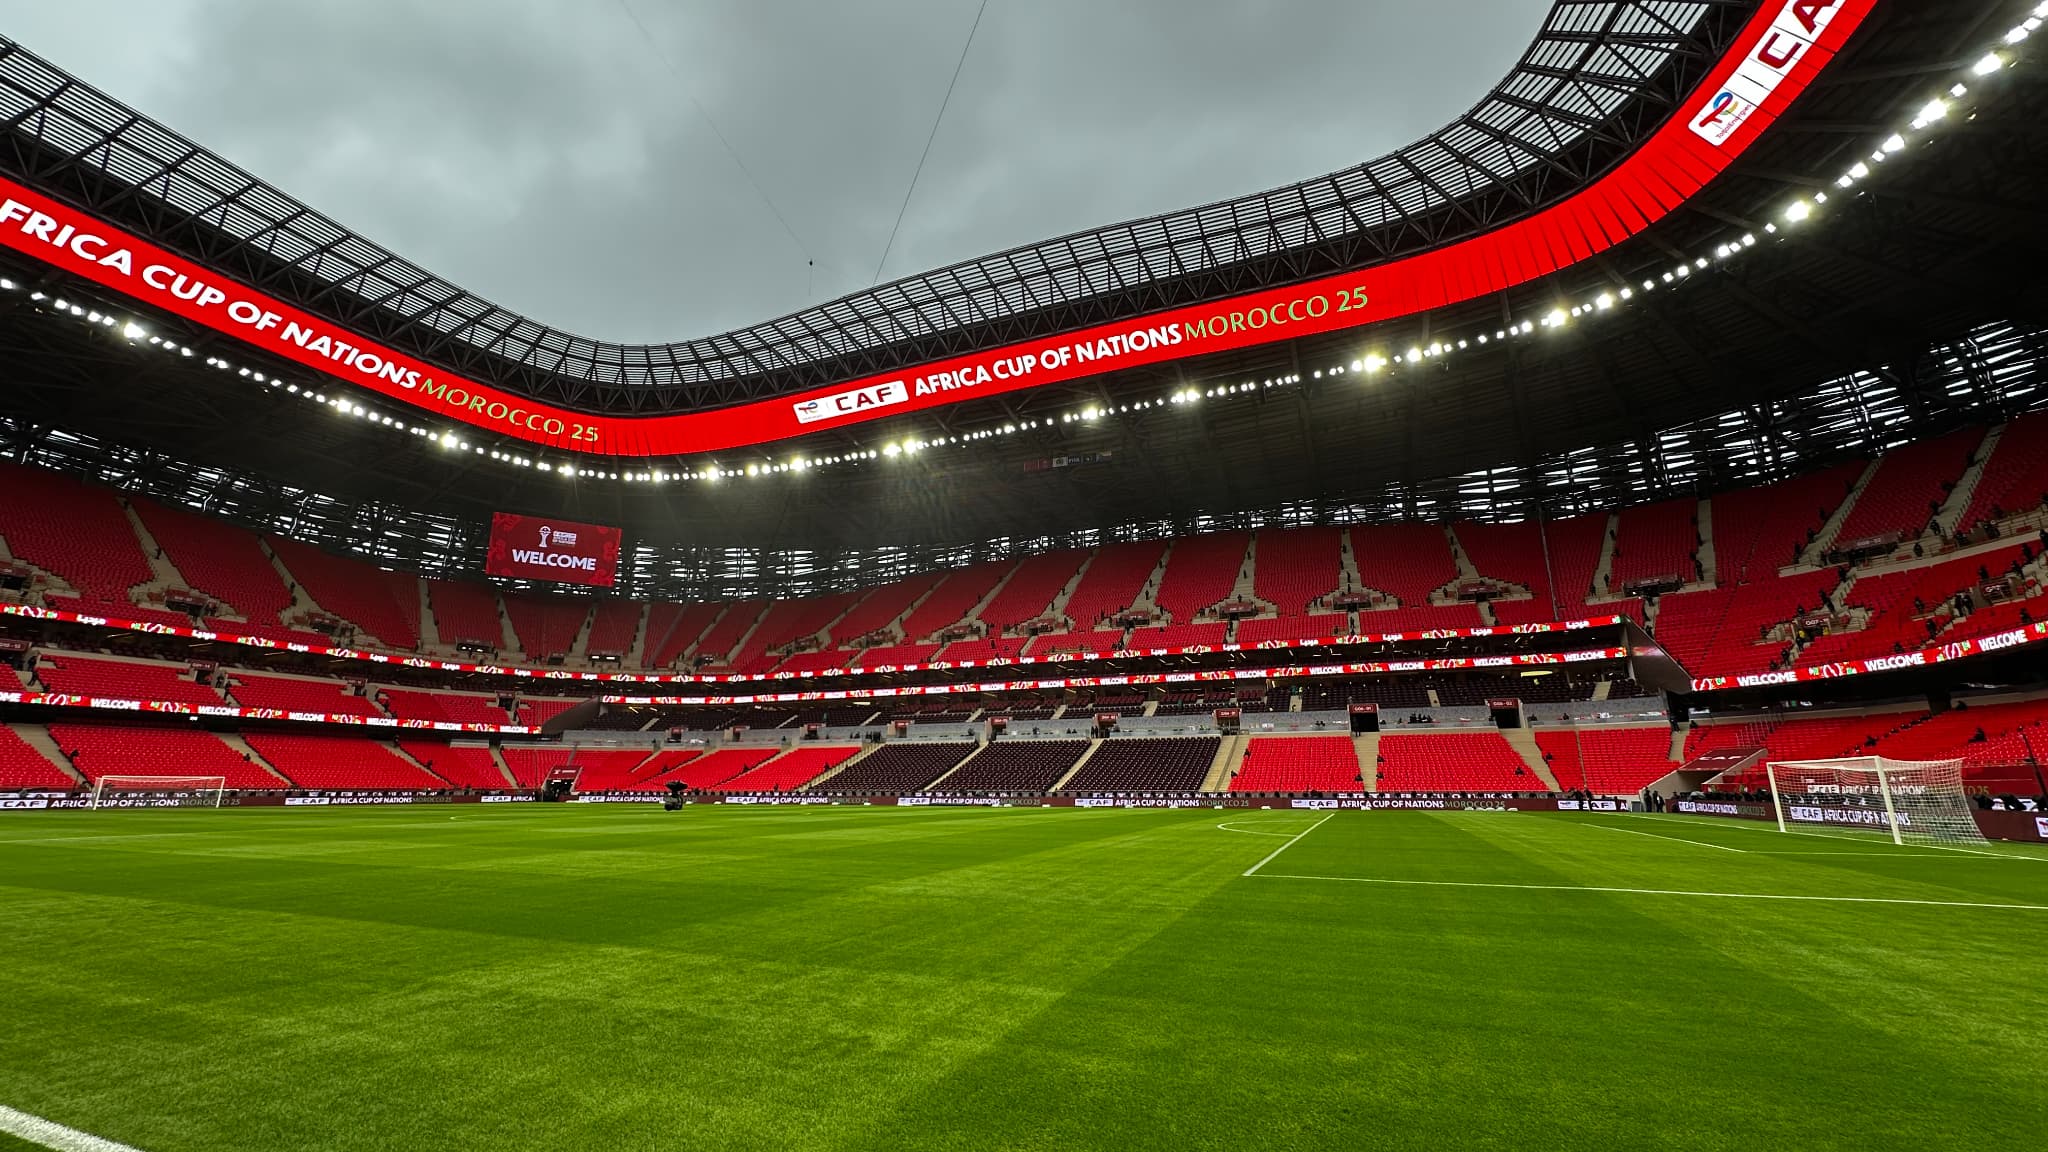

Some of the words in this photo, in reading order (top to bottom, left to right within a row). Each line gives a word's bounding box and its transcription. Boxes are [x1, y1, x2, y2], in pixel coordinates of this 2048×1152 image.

[142, 264, 226, 306] CUP
[228, 299, 282, 332] OF
[281, 321, 420, 390] NATIONS
[419, 377, 564, 435] MOROCCO
[571, 424, 599, 443] 25
[835, 386, 892, 411] CAF
[914, 366, 991, 397] AFRICA
[993, 355, 1036, 380] CUP
[1040, 347, 1072, 370] OF
[1077, 323, 1183, 361] NATIONS
[1185, 296, 1329, 340] MOROCCO
[1336, 286, 1369, 313] 25
[511, 549, 597, 571] WELCOME
[1978, 629, 2028, 651] WELCOME
[1473, 657, 1513, 667] WELCOME
[1564, 651, 1606, 662] WELCOME
[1388, 662, 1425, 671] WELCOME
[1864, 653, 1924, 672] WELCOME
[1235, 670, 1267, 679] WELCOME
[1309, 666, 1344, 675] WELCOME
[1737, 671, 1797, 687] WELCOME
[91, 698, 140, 710] WELCOME
[198, 706, 240, 716] WELCOME
[288, 712, 325, 722] WELCOME
[51, 799, 93, 807] AFRICA
[96, 799, 117, 807] CUP
[119, 799, 135, 807] OF
[1341, 800, 1372, 808] AFRICA
[1373, 800, 1390, 808] CUP
[1391, 800, 1403, 808] OF
[1405, 800, 1444, 808] NATIONS
[1445, 800, 1493, 808] MOROCCO
[1802, 808, 1819, 818] CAF
[1848, 810, 1862, 822] CUP
